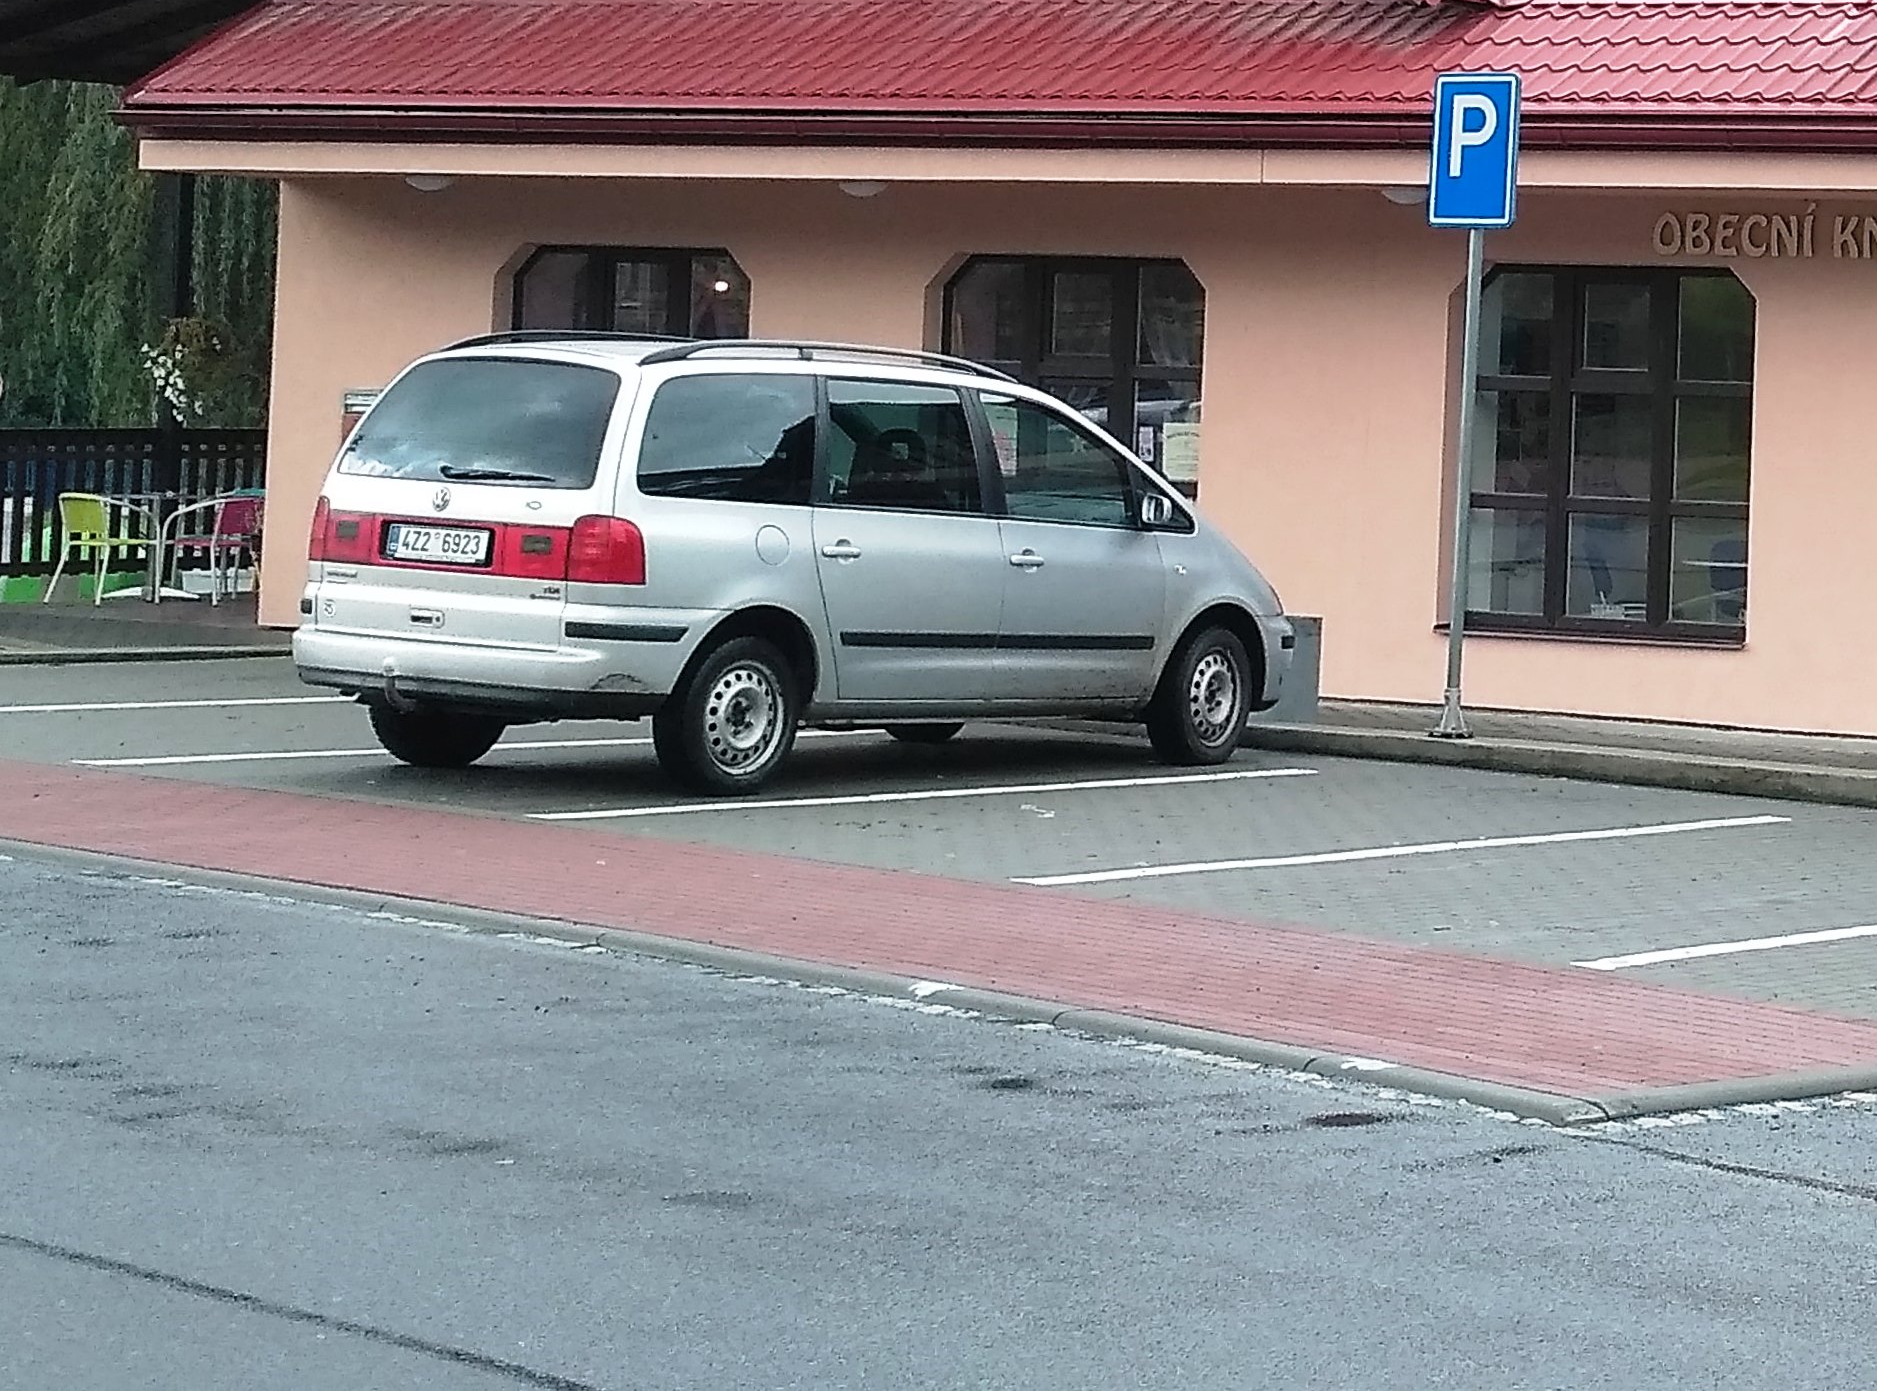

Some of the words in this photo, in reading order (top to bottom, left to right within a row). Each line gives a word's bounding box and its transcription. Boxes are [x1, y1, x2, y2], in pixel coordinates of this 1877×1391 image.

[1449, 94, 1497, 177] P
[1652, 201, 1817, 258] OBECNÍ
[401, 529, 431, 552] 4Z2
[441, 533, 481, 555] 6923
